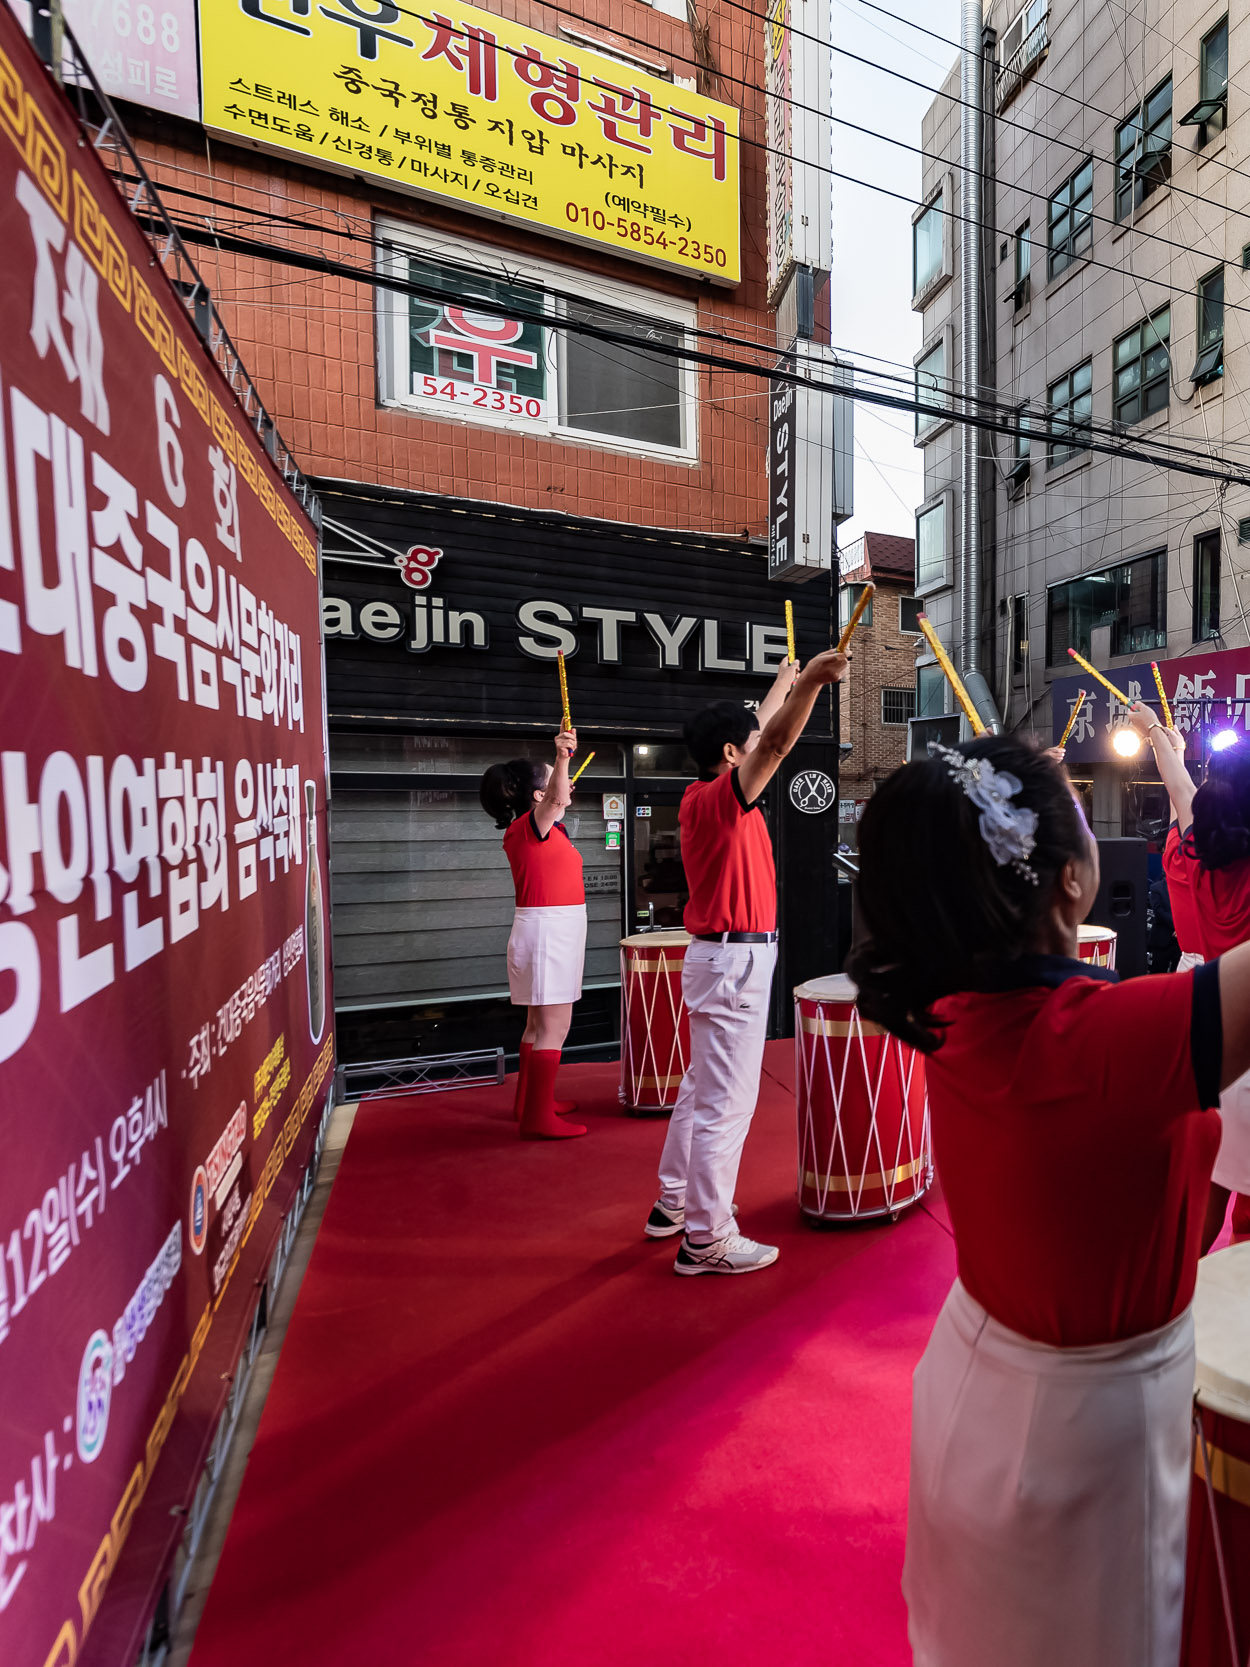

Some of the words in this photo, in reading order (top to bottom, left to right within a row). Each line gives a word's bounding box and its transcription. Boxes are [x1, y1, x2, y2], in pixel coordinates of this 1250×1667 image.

[223, 101, 314, 143] 수면도움
[333, 134, 395, 168] 신경통
[410, 157, 470, 191] 마사지
[483, 180, 540, 212] 오십견
[228, 77, 319, 118] 스트레스
[328, 104, 370, 135] 해소
[393, 127, 453, 161] 부위별
[459, 148, 535, 186] 통증관리
[333, 64, 477, 131] 중국정통
[488, 117, 549, 155] 지압
[561, 140, 646, 190] 마사지
[564, 201, 728, 268] 010-5854-2350
[603, 190, 693, 232] (예약필수)
[15, 169, 111, 437] 제
[154, 373, 186, 508] 6
[208, 443, 243, 563] 회
[422, 375, 541, 418] 54-2350
[773, 384, 793, 423] Daejin
[0, 360, 303, 733] 대중국음식문화거리
[775, 422, 790, 567] STYLE
[517, 600, 795, 674] STYLE
[234, 758, 303, 901] 음식축제
[822, 778, 832, 793] HAIR
[0, 1136, 107, 1341] 12일(수)
[108, 1069, 168, 1190] 오후4시
